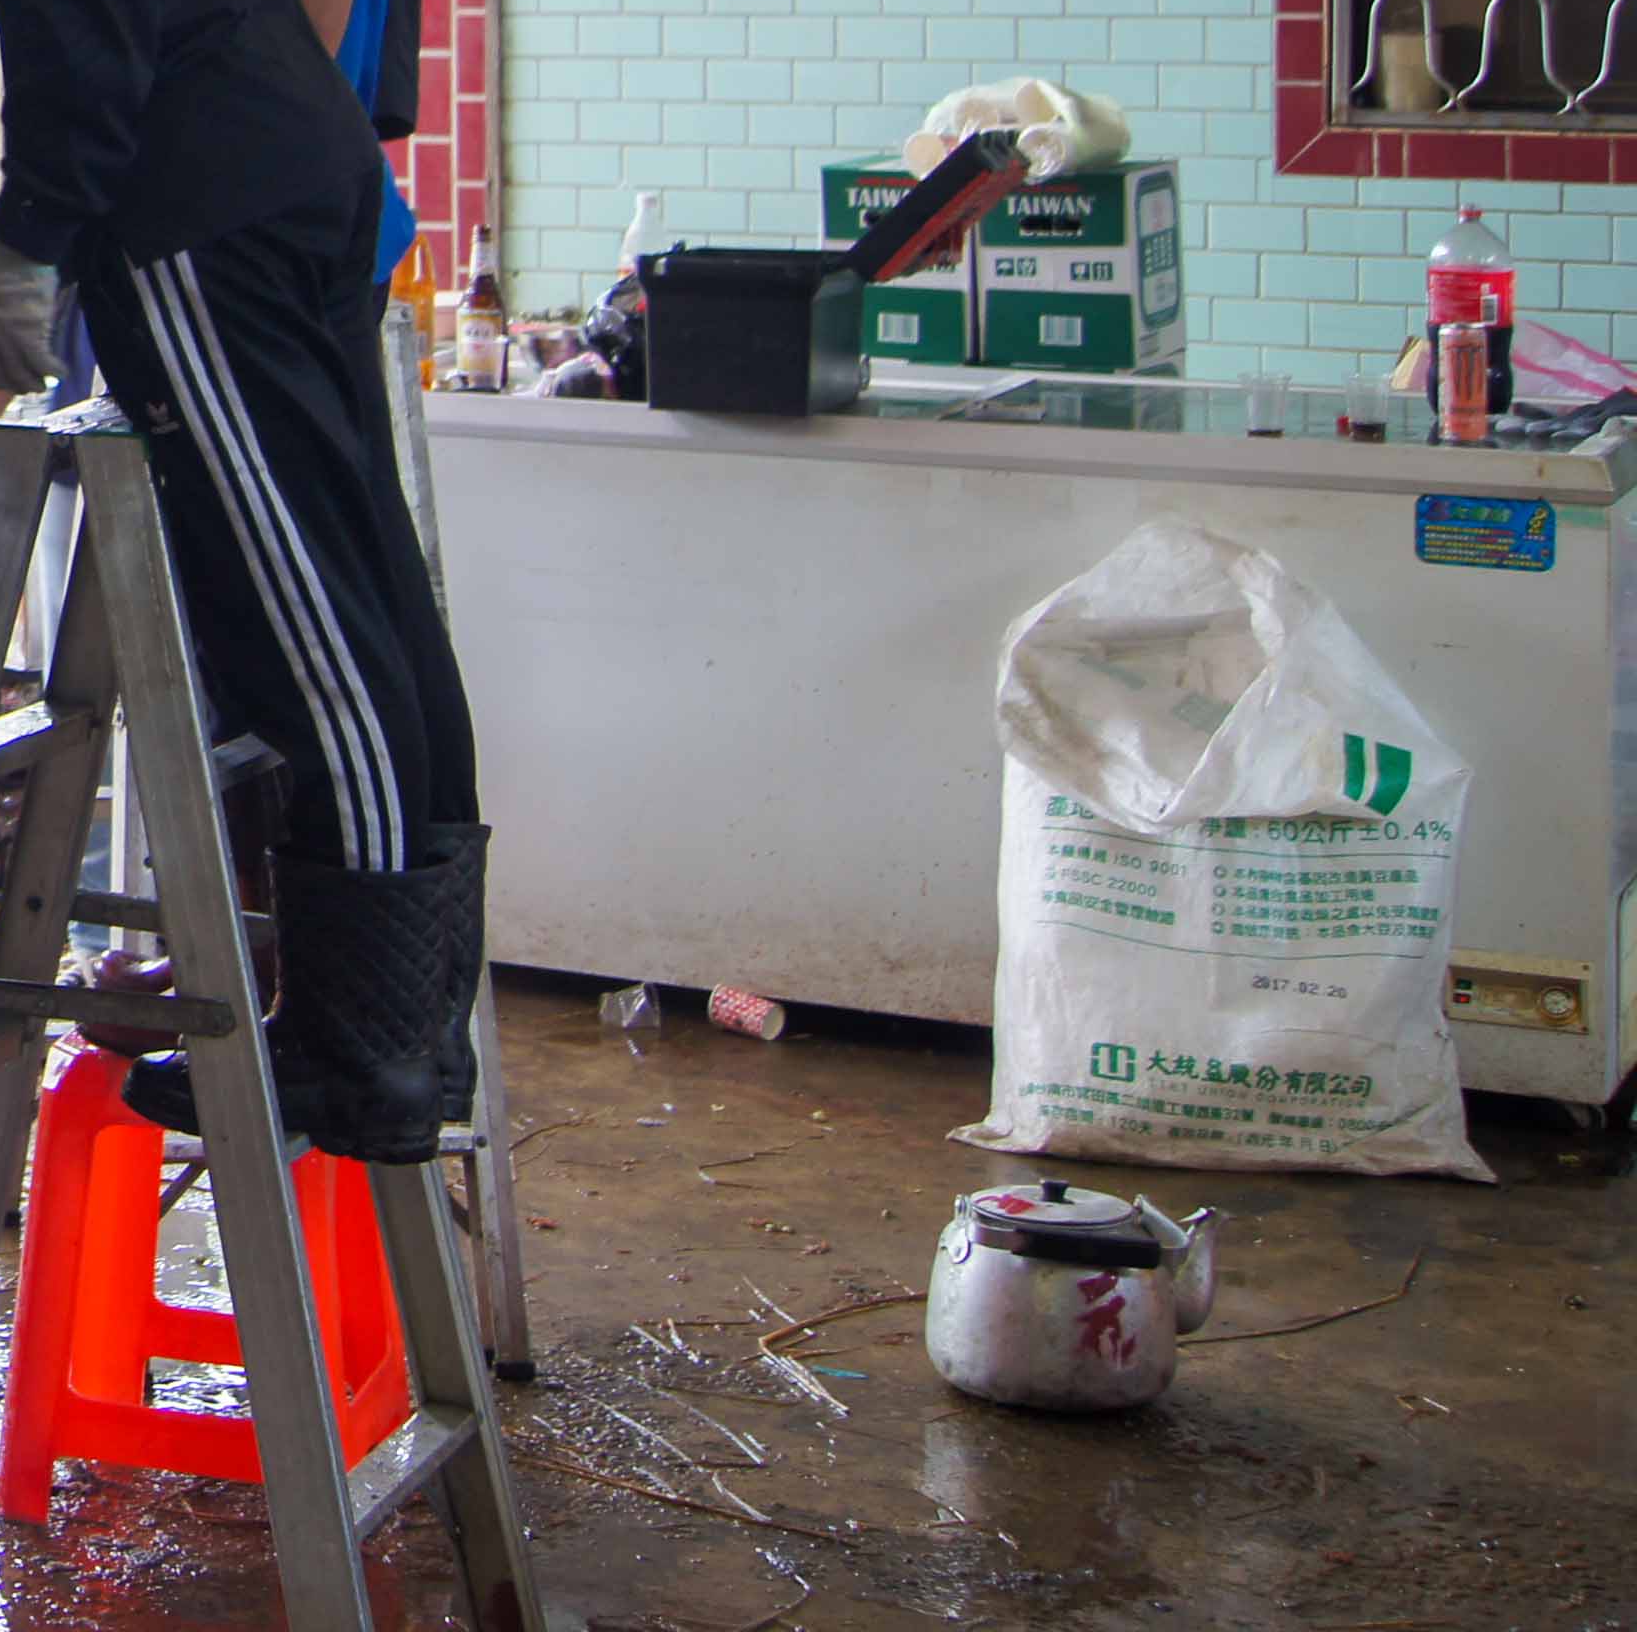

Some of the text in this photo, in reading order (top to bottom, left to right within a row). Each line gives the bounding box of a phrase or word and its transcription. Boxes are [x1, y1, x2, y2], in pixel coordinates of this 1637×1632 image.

[1006, 195, 1093, 216] TAIWAN
[1113, 854, 1143, 870] ISO
[1148, 859, 1188, 878] 9001
[1106, 875, 1158, 899] 22000
[1146, 1048, 1374, 1098] 大統益股份有限公司
